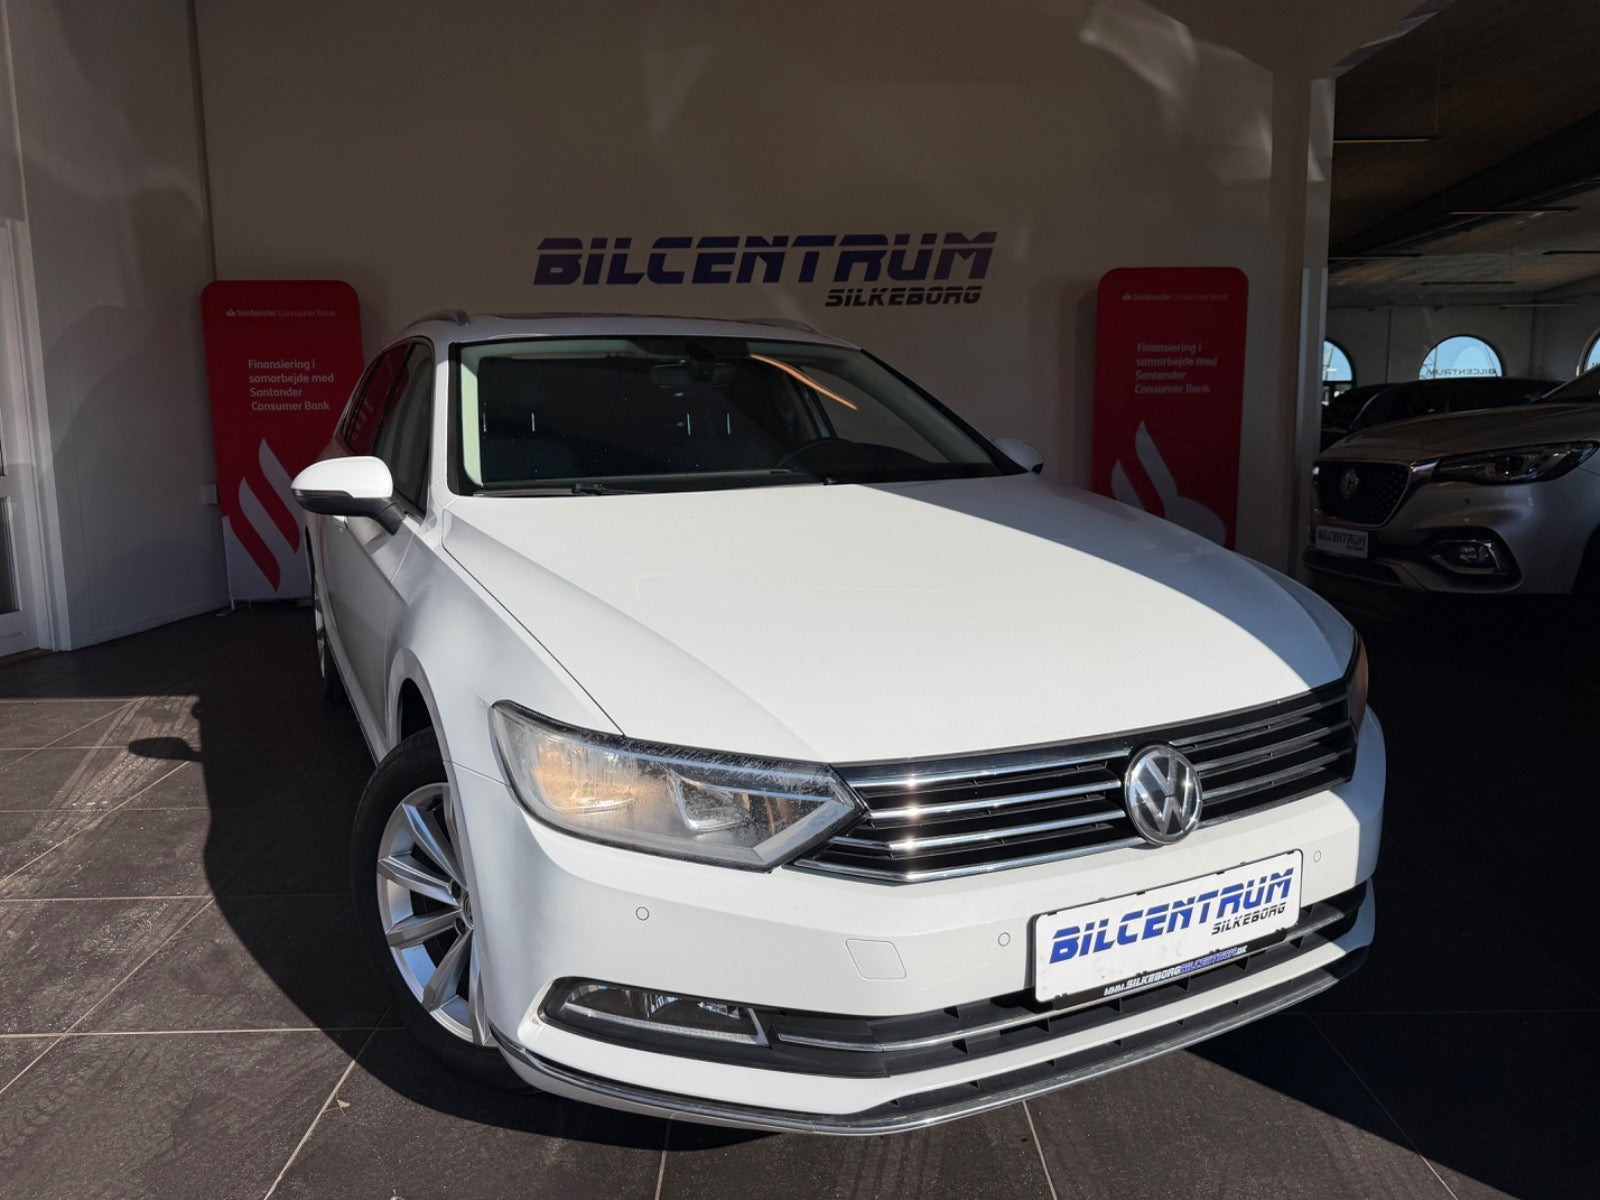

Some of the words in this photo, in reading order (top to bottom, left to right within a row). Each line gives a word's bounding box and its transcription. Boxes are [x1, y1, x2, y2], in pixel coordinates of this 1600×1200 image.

[533, 231, 998, 285] BILCENTRUM
[825, 286, 983, 307] SILKEBORG
[237, 308, 276, 317] Santander
[1137, 342, 1197, 355] Finansiering
[1198, 342, 1202, 352] i
[248, 358, 311, 371] Finansiering
[312, 358, 316, 368] i
[1136, 356, 1194, 368] samarbejde
[1195, 356, 1217, 367] med
[248, 372, 309, 385] samarbejde
[311, 372, 335, 383] med
[1135, 370, 1186, 380] Santander
[249, 387, 303, 397] Santander
[1135, 384, 1183, 394] Consumer
[1185, 383, 1210, 393] Bank
[251, 401, 303, 411] Consumer
[304, 400, 330, 410] Bank
[1049, 867, 1294, 964] BILCENTRUM
[1211, 902, 1287, 936] SILKEBORG
